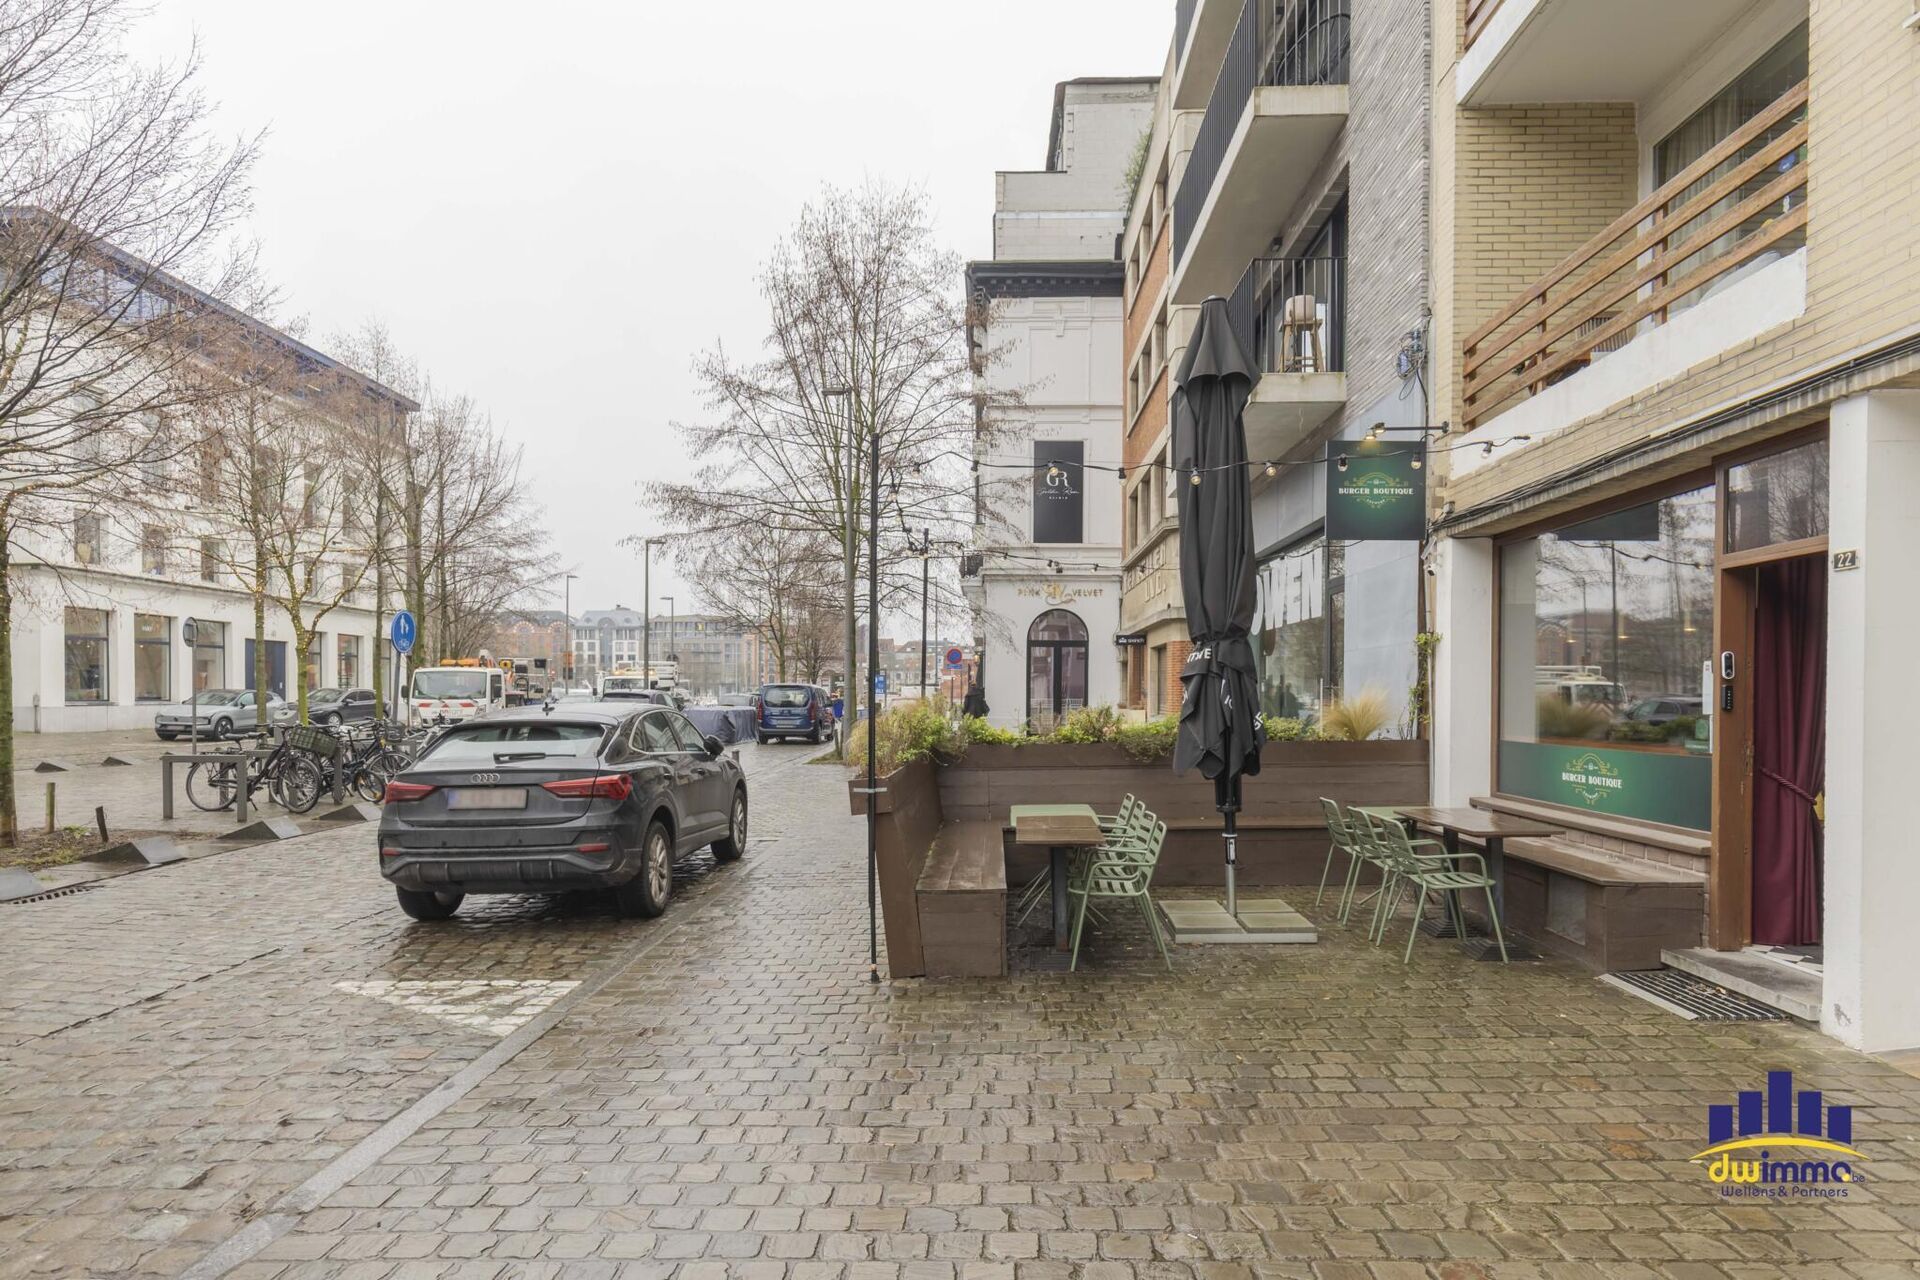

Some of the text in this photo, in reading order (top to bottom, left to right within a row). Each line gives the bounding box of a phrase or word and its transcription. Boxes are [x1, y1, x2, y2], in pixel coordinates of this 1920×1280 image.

[1338, 487, 1414, 495] BURGER BOUTIQUE
[1837, 552, 1852, 568] 22
[1017, 588, 1040, 597] PINK
[1072, 588, 1104, 597] VELVET
[1562, 772, 1623, 789] BURGER BOUTIQUE
